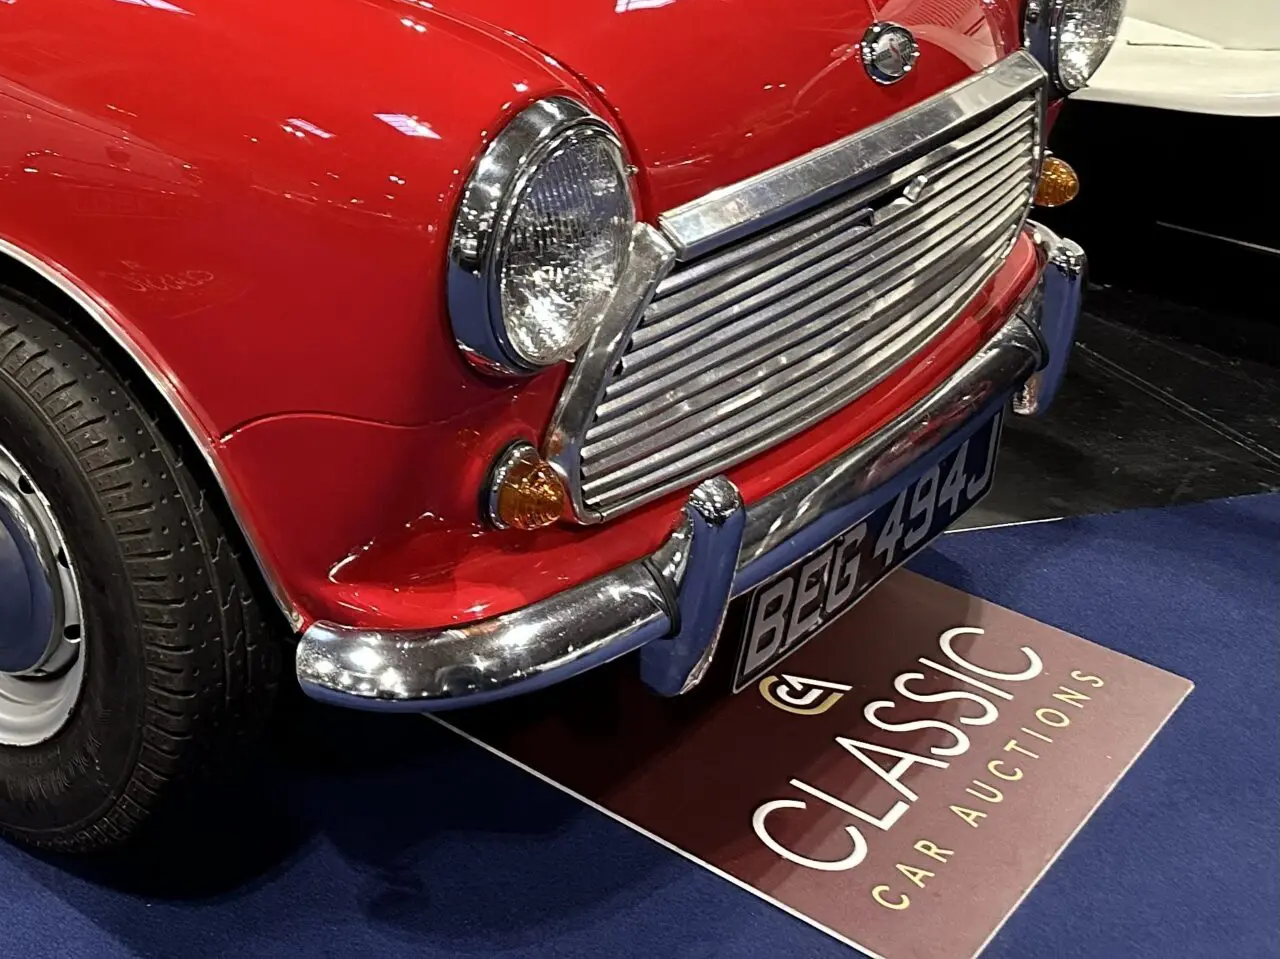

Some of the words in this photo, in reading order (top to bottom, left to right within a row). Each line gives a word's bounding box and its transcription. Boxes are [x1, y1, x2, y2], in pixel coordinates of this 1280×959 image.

[742, 521, 868, 677] BEG
[873, 411, 1001, 568] 494J
[751, 626, 1044, 872] CLASSIC
[871, 838, 955, 911] CAR
[948, 669, 1105, 829] AUCTIONS
